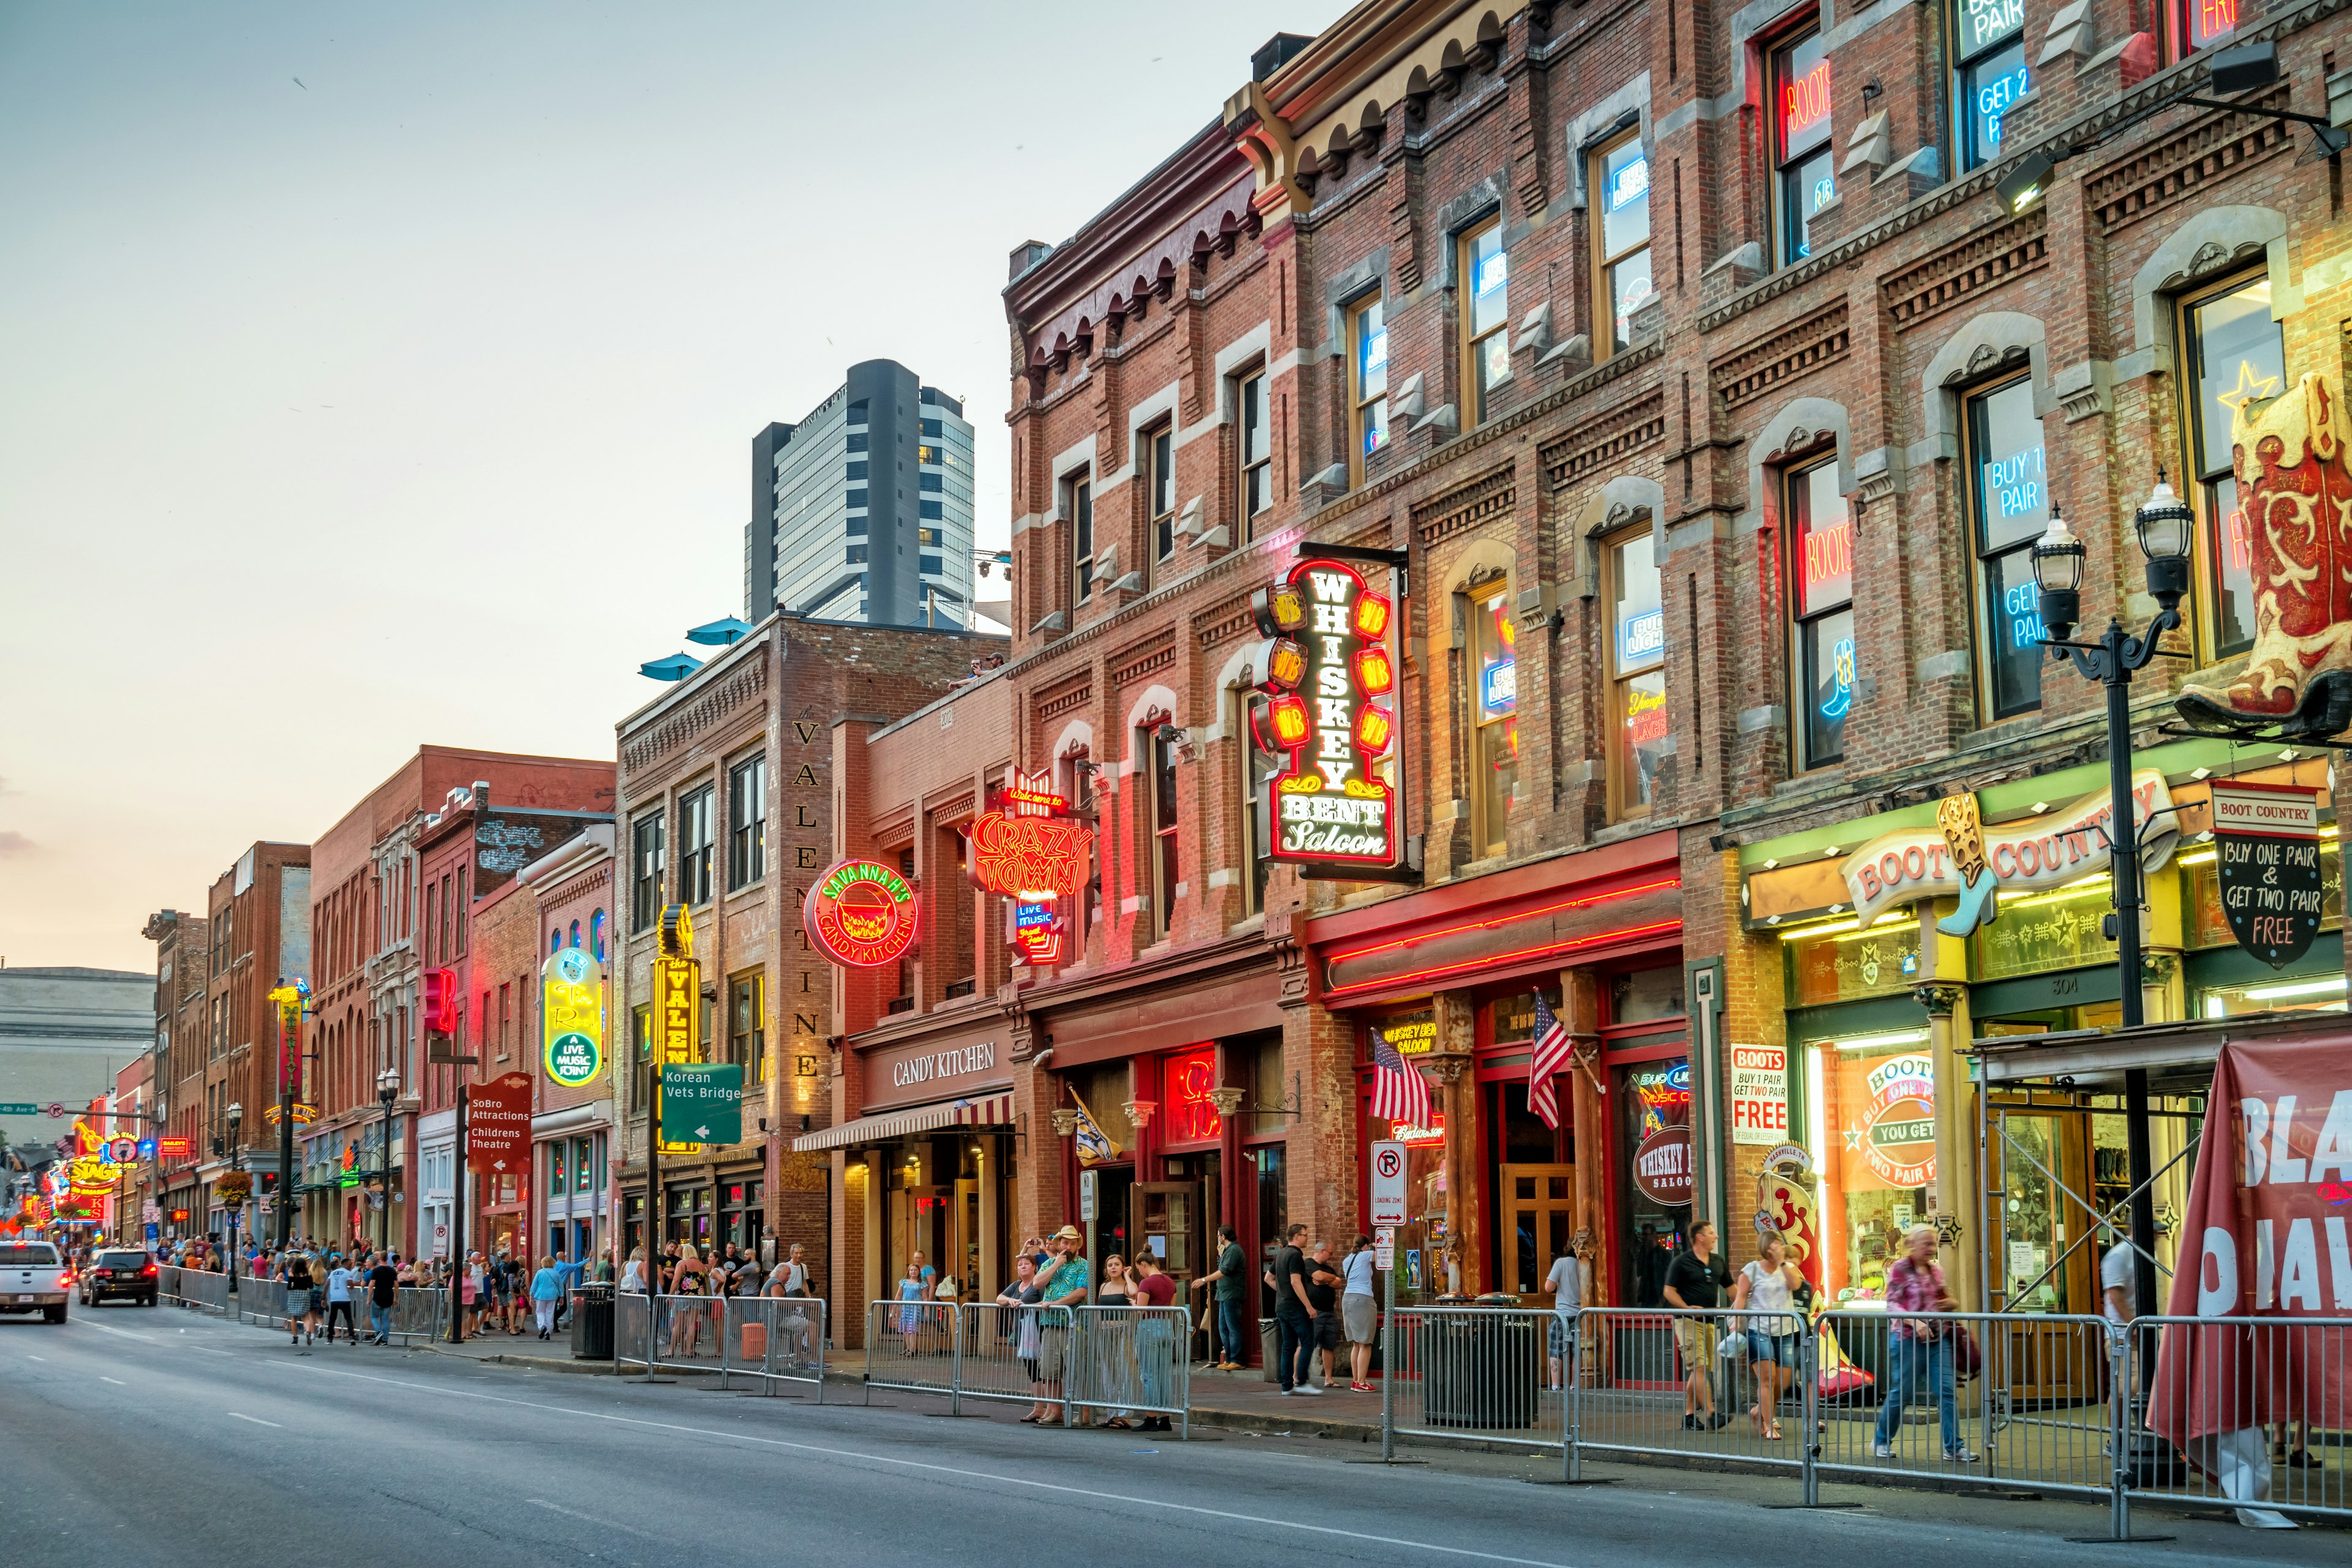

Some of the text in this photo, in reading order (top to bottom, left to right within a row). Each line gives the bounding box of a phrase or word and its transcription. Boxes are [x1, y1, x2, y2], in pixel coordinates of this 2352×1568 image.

[1975, 0, 2024, 44] PAIR
[1980, 68, 2027, 114] GET 2
[1619, 160, 1646, 186] BUD
[1485, 252, 1507, 276] BUD
[1992, 448, 2041, 489] BUY 1
[2000, 481, 2038, 518] PAIR
[1273, 594, 1301, 624] WB
[2006, 581, 2037, 615] GET
[1357, 601, 1385, 631] WB
[1629, 629, 1664, 654] LIGH
[2015, 614, 2045, 647] PAI
[1273, 650, 1301, 681] WB
[1360, 659, 1389, 689] WB
[1310, 572, 1353, 790] WHISKEY
[797, 705, 814, 720] the
[941, 710, 952, 726] 2012
[1275, 709, 1305, 739] WB
[1360, 714, 1388, 745] WB
[1633, 718, 1667, 742] LAGE
[1010, 788, 1062, 806] Welcome to
[1281, 794, 1385, 826] BENT
[2220, 803, 2310, 820] BOOT COUNTRY
[972, 812, 1095, 859] CRAZY
[1283, 821, 1386, 855] Saloon
[1857, 780, 2157, 902] BOOT COUNTY
[2225, 842, 2316, 868] BUY ONE PAIR
[823, 864, 911, 903] SAVANNAH'S
[976, 856, 1079, 895] TOWN
[2263, 867, 2277, 884] &
[1020, 905, 1041, 915] LIVE
[2226, 886, 2320, 913] GET TWO PAIR
[821, 916, 859, 958] CANDY
[863, 918, 911, 961] KITCHEN
[1019, 926, 1041, 938] Great
[1025, 932, 1046, 946] Food
[2253, 916, 2294, 946] FREE
[669, 957, 688, 969] the
[554, 983, 592, 1006] Tin
[2053, 978, 2078, 995] 304
[550, 1007, 598, 1035] Roof
[1385, 1023, 1436, 1042] WHISKEY BEN
[284, 1006, 298, 1094] MARGARITAVILL
[564, 1045, 584, 1054] LIVE
[1397, 1038, 1431, 1054] SALOON
[557, 1056, 591, 1065] MUSIC
[894, 1042, 994, 1087] CANDY KITCHEN
[1737, 1050, 1783, 1068] BOOTS
[559, 1066, 589, 1076] JOINT
[666, 1072, 710, 1083] Korean
[1641, 1073, 1667, 1085] BUD
[1738, 1073, 1781, 1085] BUY 1 PAIR
[1870, 1060, 1934, 1092] BOOT
[667, 1087, 741, 1101] Vets Bridge
[1644, 1092, 1677, 1103] MUSIC
[1734, 1085, 1785, 1097] GET TWO PAIR
[473, 1099, 502, 1108] SoBro
[1735, 1100, 1787, 1129] FREE
[1862, 1092, 1885, 1125] BUY
[1890, 1081, 1917, 1098] ONE
[472, 1111, 529, 1120] Attractions
[107, 1132, 140, 1142] BIG TIME
[472, 1128, 520, 1137] Childrens
[1393, 1126, 1444, 1142] Budweiser
[1741, 1131, 1754, 1140] EQUAL
[1760, 1133, 1777, 1141] LESSER
[1881, 1122, 1934, 1140] YOU GET
[472, 1139, 511, 1148] Theatre
[1640, 1144, 1683, 1177] WHISKEY
[1770, 1149, 1797, 1163] NASHVILLE,
[1865, 1147, 1891, 1177] TWO
[1894, 1168, 1924, 1183] PAIR
[70, 1159, 123, 1182] STAGE
[1084, 1175, 1090, 1188] NO
[1654, 1177, 1691, 1188] SALOO
[180, 1210, 188, 1219] 22
